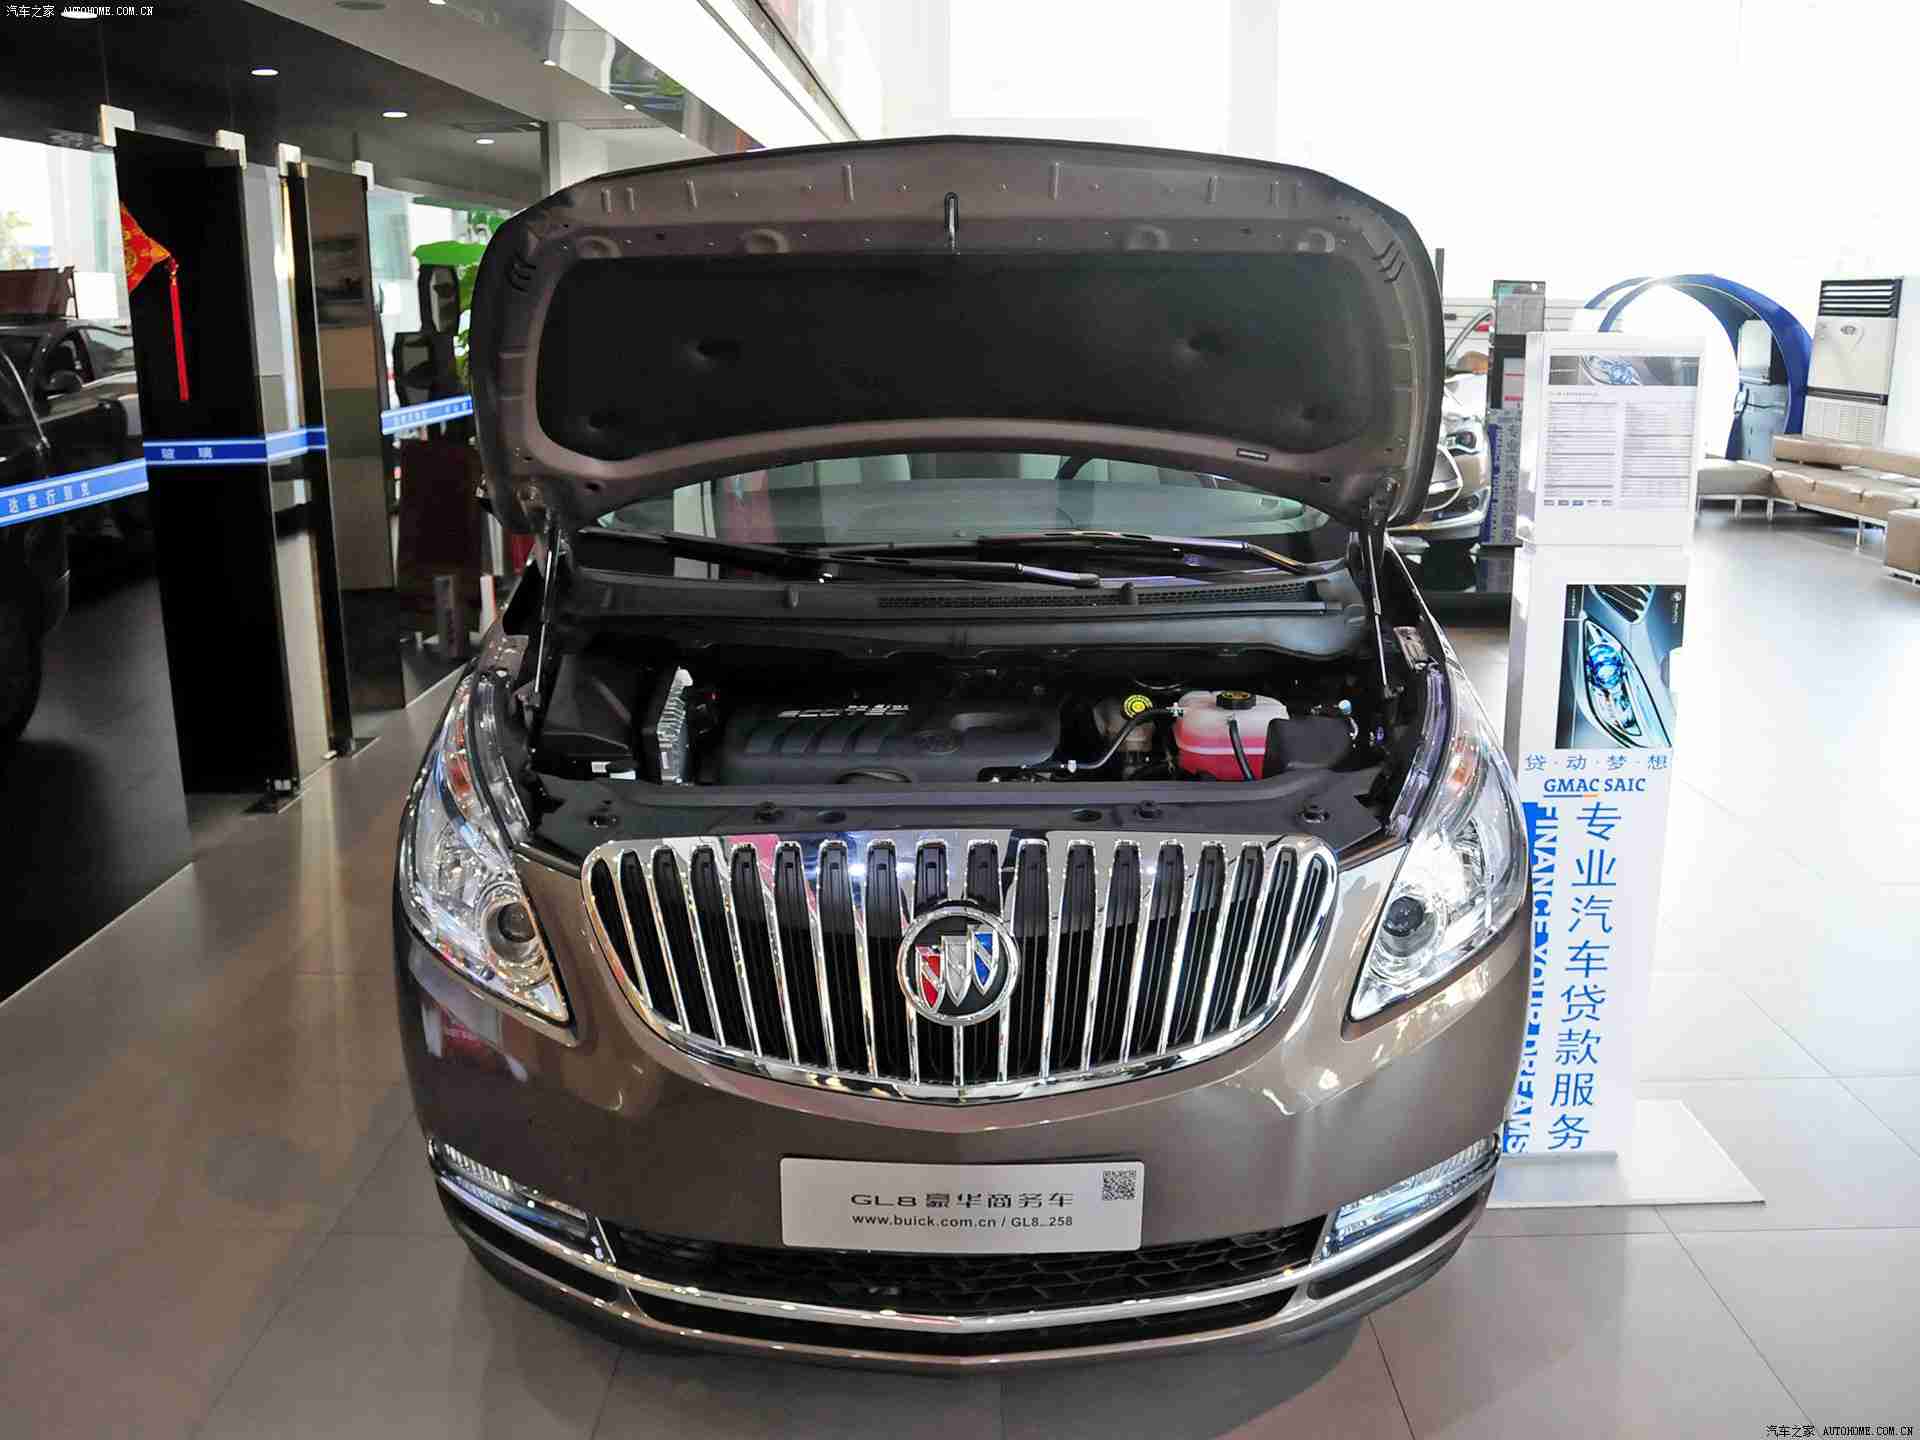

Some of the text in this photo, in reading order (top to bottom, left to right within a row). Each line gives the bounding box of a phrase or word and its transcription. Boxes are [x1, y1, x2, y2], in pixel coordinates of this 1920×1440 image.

[1544, 778, 1646, 792] GMAC SAIC
[1547, 801, 1622, 1151] 专业汽车贷款服务
[852, 1215, 996, 1227] www.buick.com.cn
[1011, 1216, 1072, 1227] GL8_258
